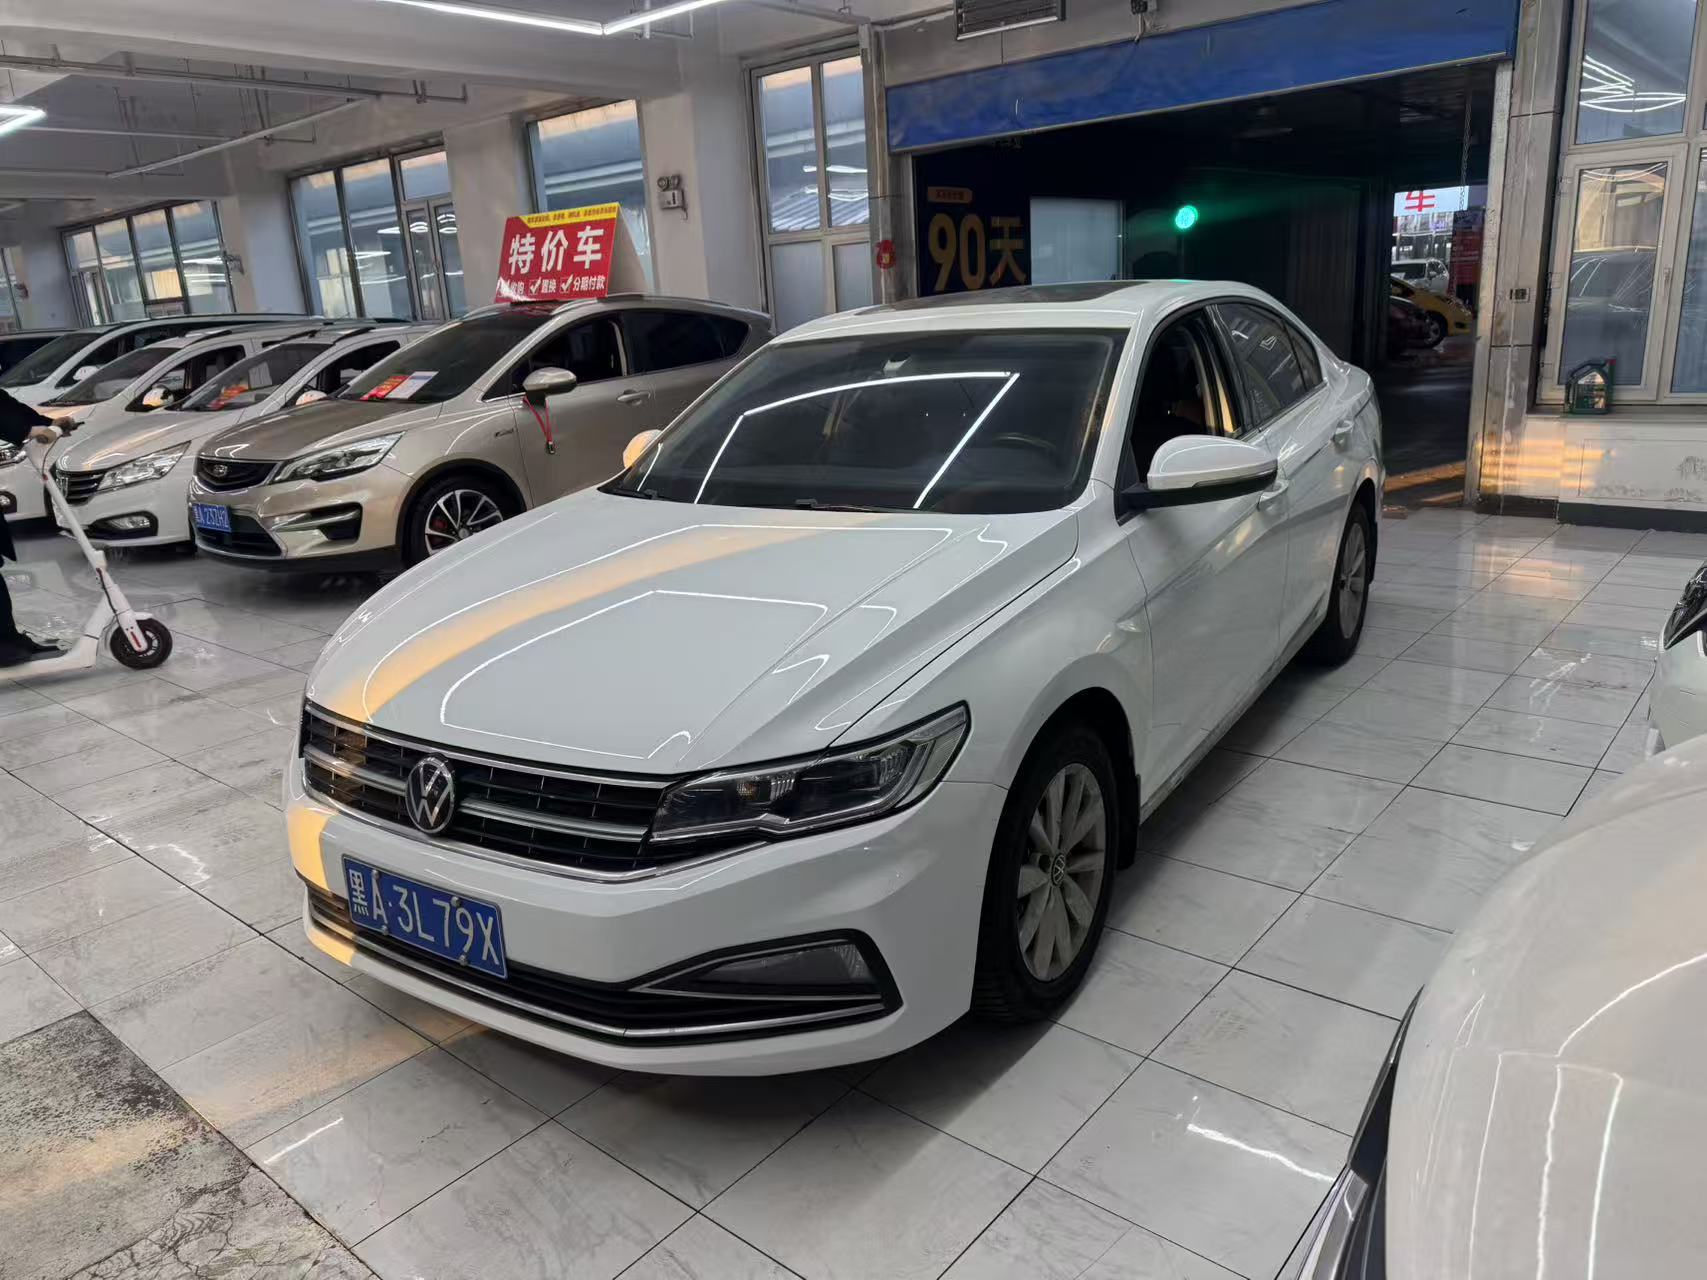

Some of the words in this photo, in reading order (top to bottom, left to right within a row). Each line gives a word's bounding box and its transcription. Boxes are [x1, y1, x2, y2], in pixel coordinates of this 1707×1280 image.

[508, 225, 604, 275] 特价车
[928, 213, 1026, 291] 90天
[541, 279, 557, 293] 置换
[572, 275, 606, 291] 分期付款
